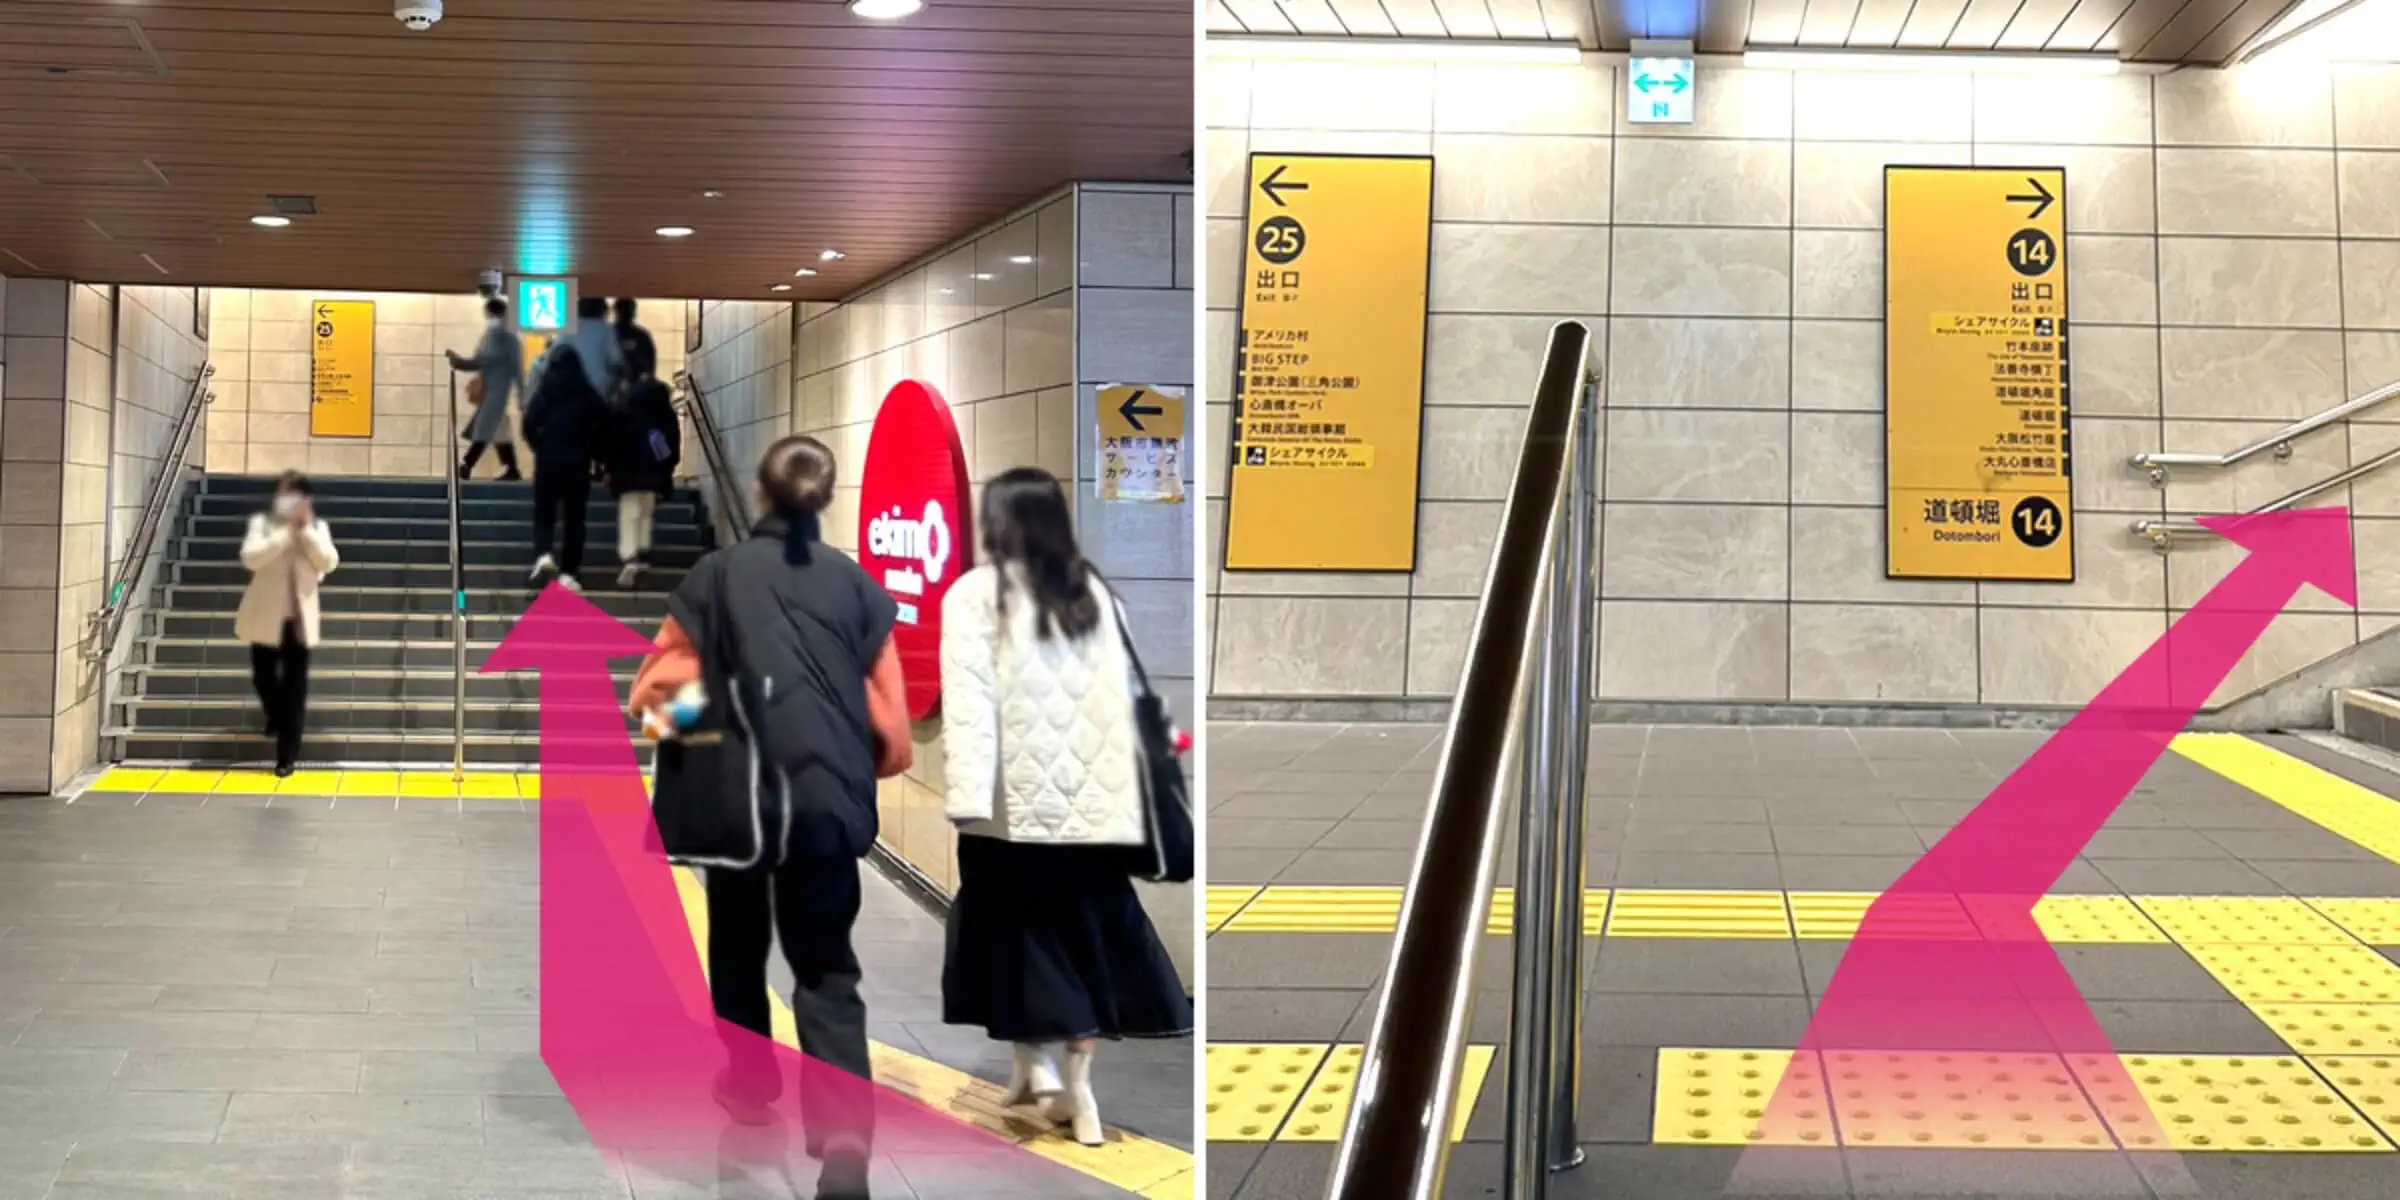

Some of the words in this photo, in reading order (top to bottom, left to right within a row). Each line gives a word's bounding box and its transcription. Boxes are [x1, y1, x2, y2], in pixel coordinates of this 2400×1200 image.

[1262, 226, 1299, 254] 25
[2013, 239, 2049, 266] 14
[1256, 269, 1300, 289] 出口
[2011, 281, 2053, 300] 出口
[1253, 329, 1309, 343] アメリカ村
[1277, 353, 1309, 366] STEP
[1924, 498, 2000, 524] 道頓堀
[2017, 508, 2056, 537] 14
[1933, 530, 2000, 543] Dotombori
